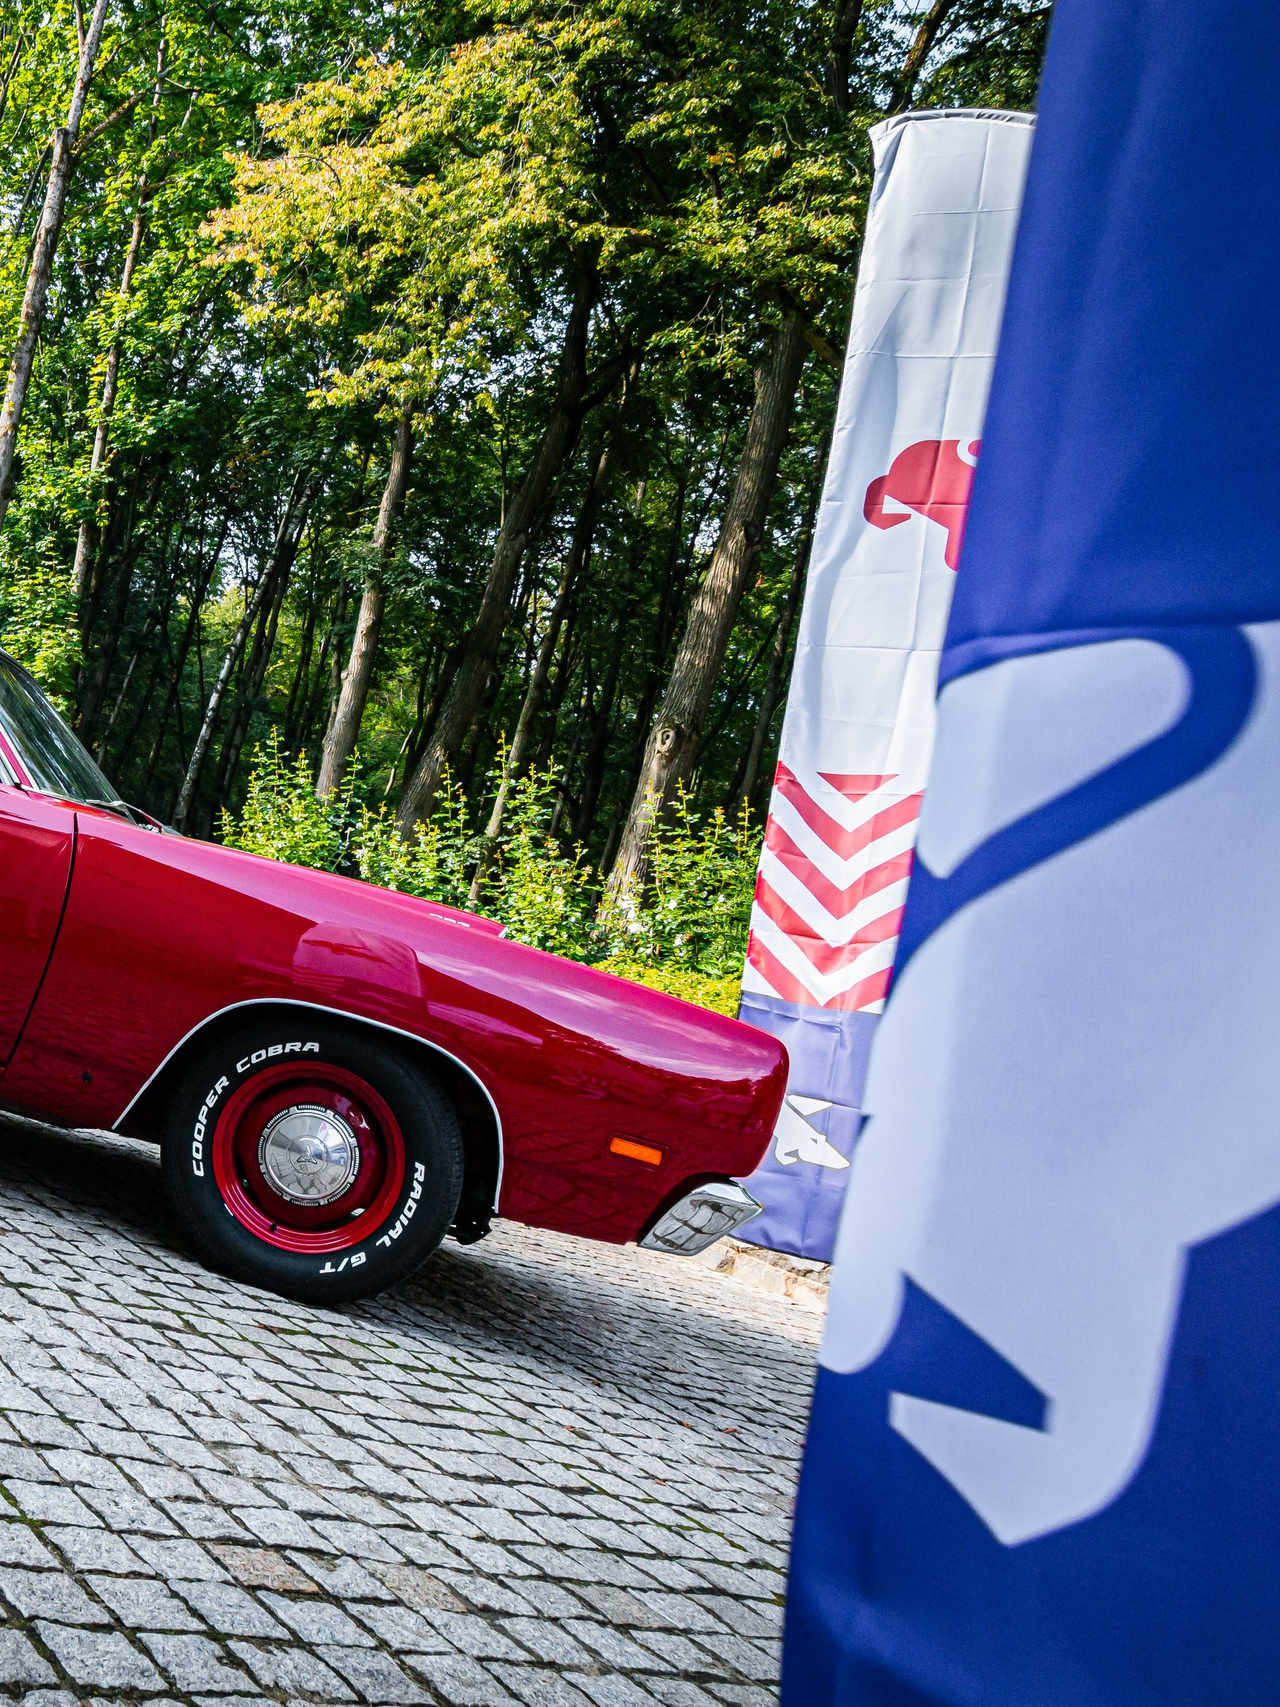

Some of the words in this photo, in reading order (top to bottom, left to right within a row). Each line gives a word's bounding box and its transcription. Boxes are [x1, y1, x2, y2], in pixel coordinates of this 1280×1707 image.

[192, 1076, 230, 1177] COOPER
[236, 1042, 320, 1073] COBRA
[375, 1161, 425, 1248] RADIAL
[319, 1252, 367, 1274] G/T
